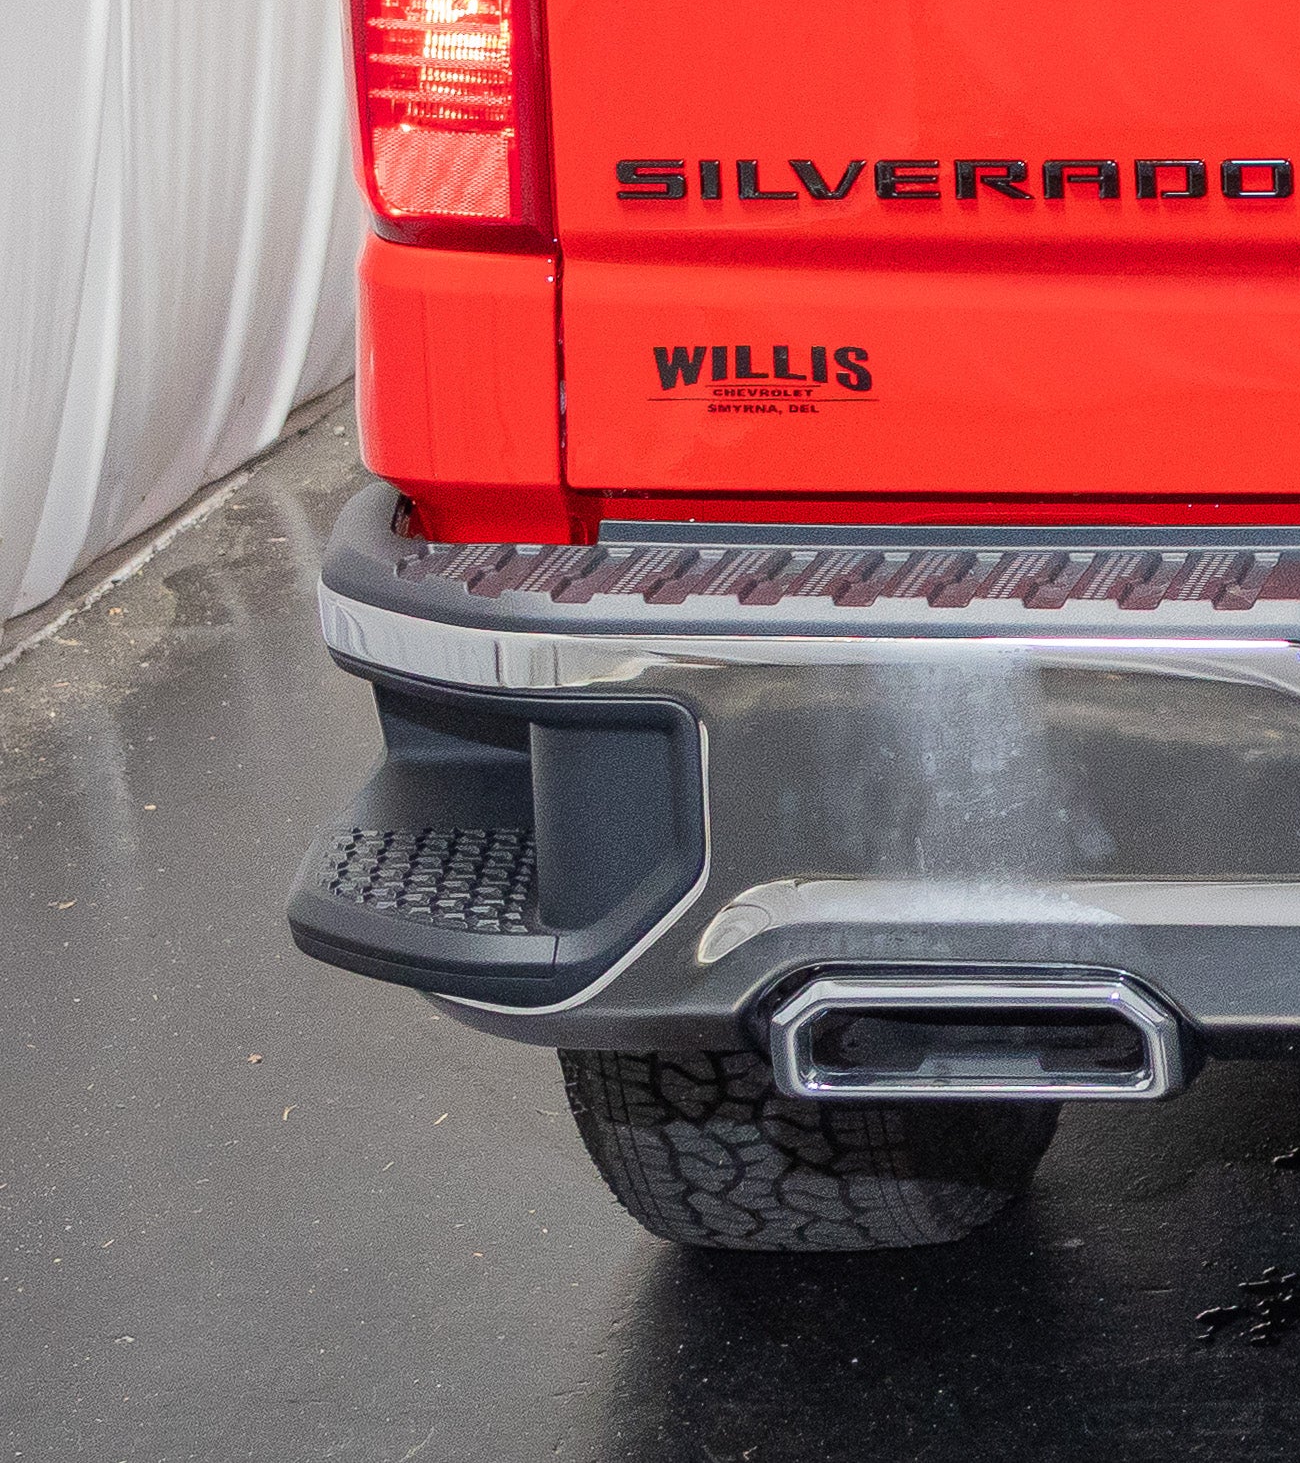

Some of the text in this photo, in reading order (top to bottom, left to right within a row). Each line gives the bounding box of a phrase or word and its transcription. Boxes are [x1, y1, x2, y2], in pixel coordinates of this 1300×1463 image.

[615, 157, 1296, 202] SILVERADO
[653, 345, 873, 392] WILLIS
[713, 388, 813, 398] CHEVROLET
[707, 403, 820, 415] SMYRNA, DEL
